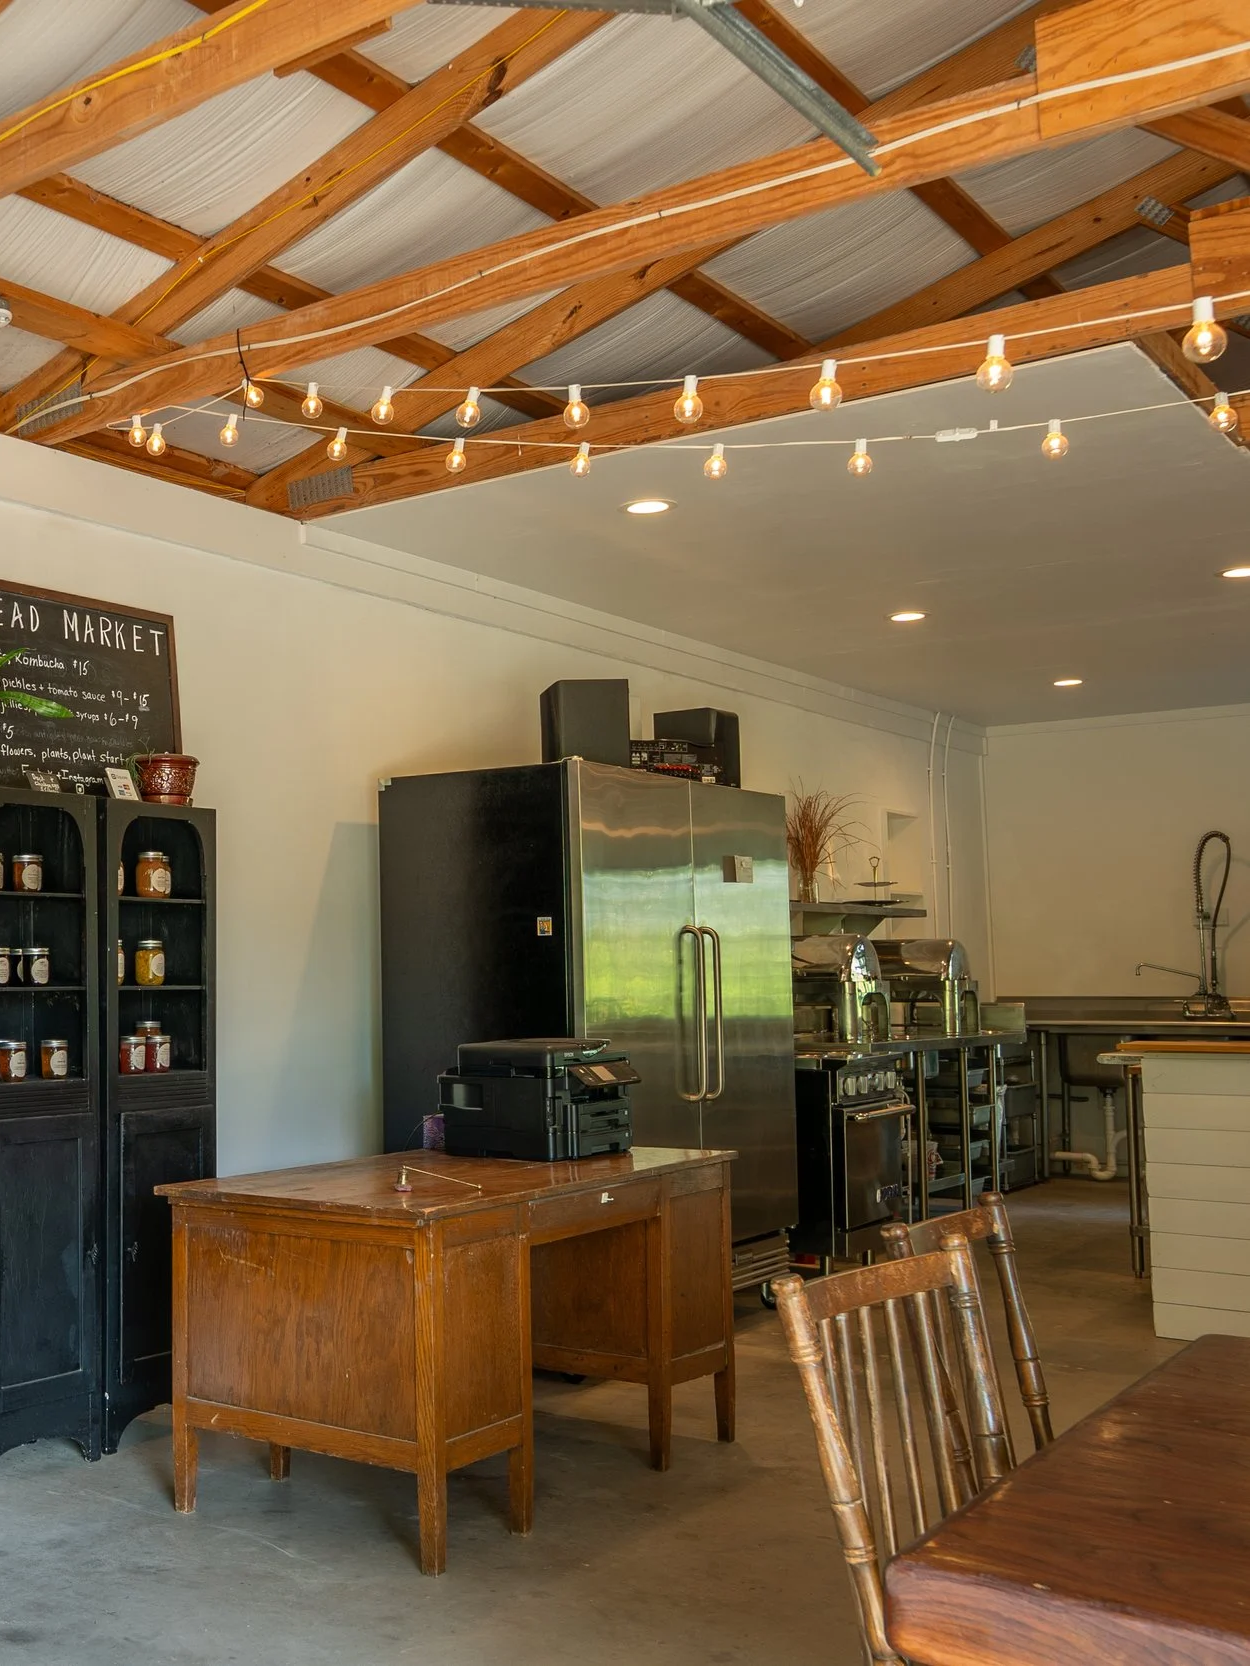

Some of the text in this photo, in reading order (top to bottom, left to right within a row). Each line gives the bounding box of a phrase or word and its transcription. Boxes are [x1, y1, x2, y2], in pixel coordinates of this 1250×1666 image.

[62, 609, 165, 656] MARKET
[15, 653, 65, 670] Kombucha
[72, 659, 90, 676] $15
[1, 677, 37, 692] pickles
[47, 683, 79, 698] tomato
[82, 690, 106, 703] sauce
[75, 712, 100, 723] syrups
[2, 722, 15, 740] $5
[72, 750, 96, 765] plant
[61, 769, 104, 787] Instagram
